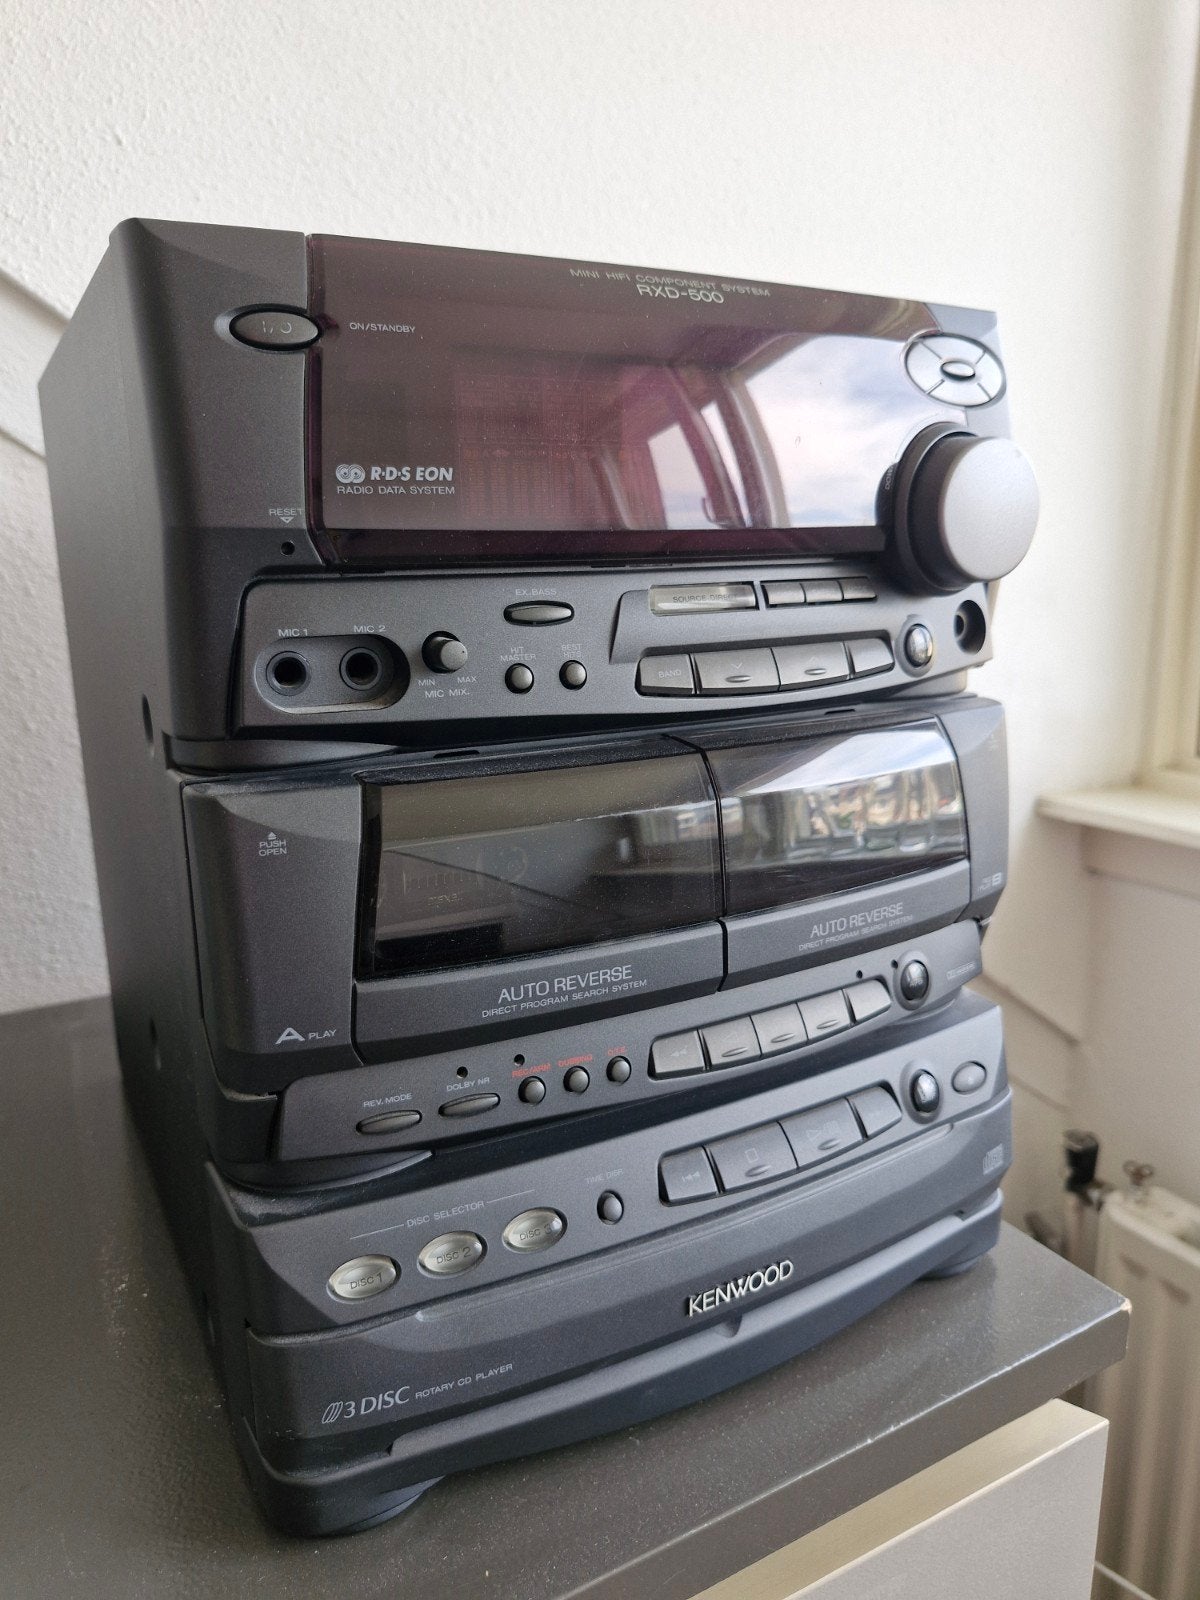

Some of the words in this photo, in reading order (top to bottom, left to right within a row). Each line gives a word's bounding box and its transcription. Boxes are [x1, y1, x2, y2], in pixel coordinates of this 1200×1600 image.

[570, 268, 600, 279] MINI
[606, 272, 631, 282] HIFI
[636, 274, 717, 291] COMPONENT
[721, 283, 771, 297] SYSTEM
[637, 284, 725, 304] RXD-500
[349, 321, 416, 334] ON/STANDBY
[415, 467, 454, 482] EON
[336, 486, 374, 495] RADIO
[378, 486, 406, 495] DATA
[410, 486, 455, 495] SYSTEM
[269, 508, 304, 516] RESET
[277, 628, 301, 638] MIC
[303, 628, 309, 637] 1
[353, 625, 375, 634] MIC
[377, 624, 386, 633] 2
[510, 646, 524, 654] HIT
[500, 653, 537, 662] MASTER
[417, 678, 436, 687] MIN
[457, 675, 478, 684] MAX
[424, 689, 445, 699] MIC
[449, 688, 471, 697] MIX.
[259, 839, 287, 848] PUSH
[258, 848, 288, 857] OPEN
[810, 917, 847, 939] AUTO
[849, 902, 904, 928] REVERSE
[798, 939, 825, 951] DIRECT
[825, 930, 860, 944] PROGRAM
[861, 923, 887, 935] SEARCH
[889, 914, 914, 927] SYSTEM
[498, 980, 550, 1004] AUTO
[554, 964, 633, 993] REVERSE
[482, 1004, 517, 1018] DIRECT
[520, 995, 569, 1011] PROGRAM
[572, 987, 609, 1001] SEARCH
[612, 979, 648, 993] SYSTEM
[275, 1027, 306, 1045] A
[308, 1029, 337, 1040] PLAY
[557, 1054, 593, 1067] DUBBING
[446, 1080, 476, 1091] DOLBY
[477, 1077, 490, 1086] NR
[363, 1098, 384, 1107] REV.
[386, 1092, 413, 1105] MODE
[406, 1214, 431, 1227] DISC
[433, 1201, 485, 1220] SELECTOR
[519, 1228, 542, 1241] DISC
[436, 1251, 460, 1265] DISC
[462, 1246, 472, 1258] 2
[350, 1276, 375, 1290] DISC
[376, 1274, 383, 1283] 1
[688, 1260, 794, 1317] KENWOOD
[343, 1401, 356, 1419] 3
[360, 1386, 410, 1415] DISC
[415, 1381, 455, 1399] ROTARY
[457, 1376, 472, 1387] CD
[475, 1363, 513, 1381] PLAYER
